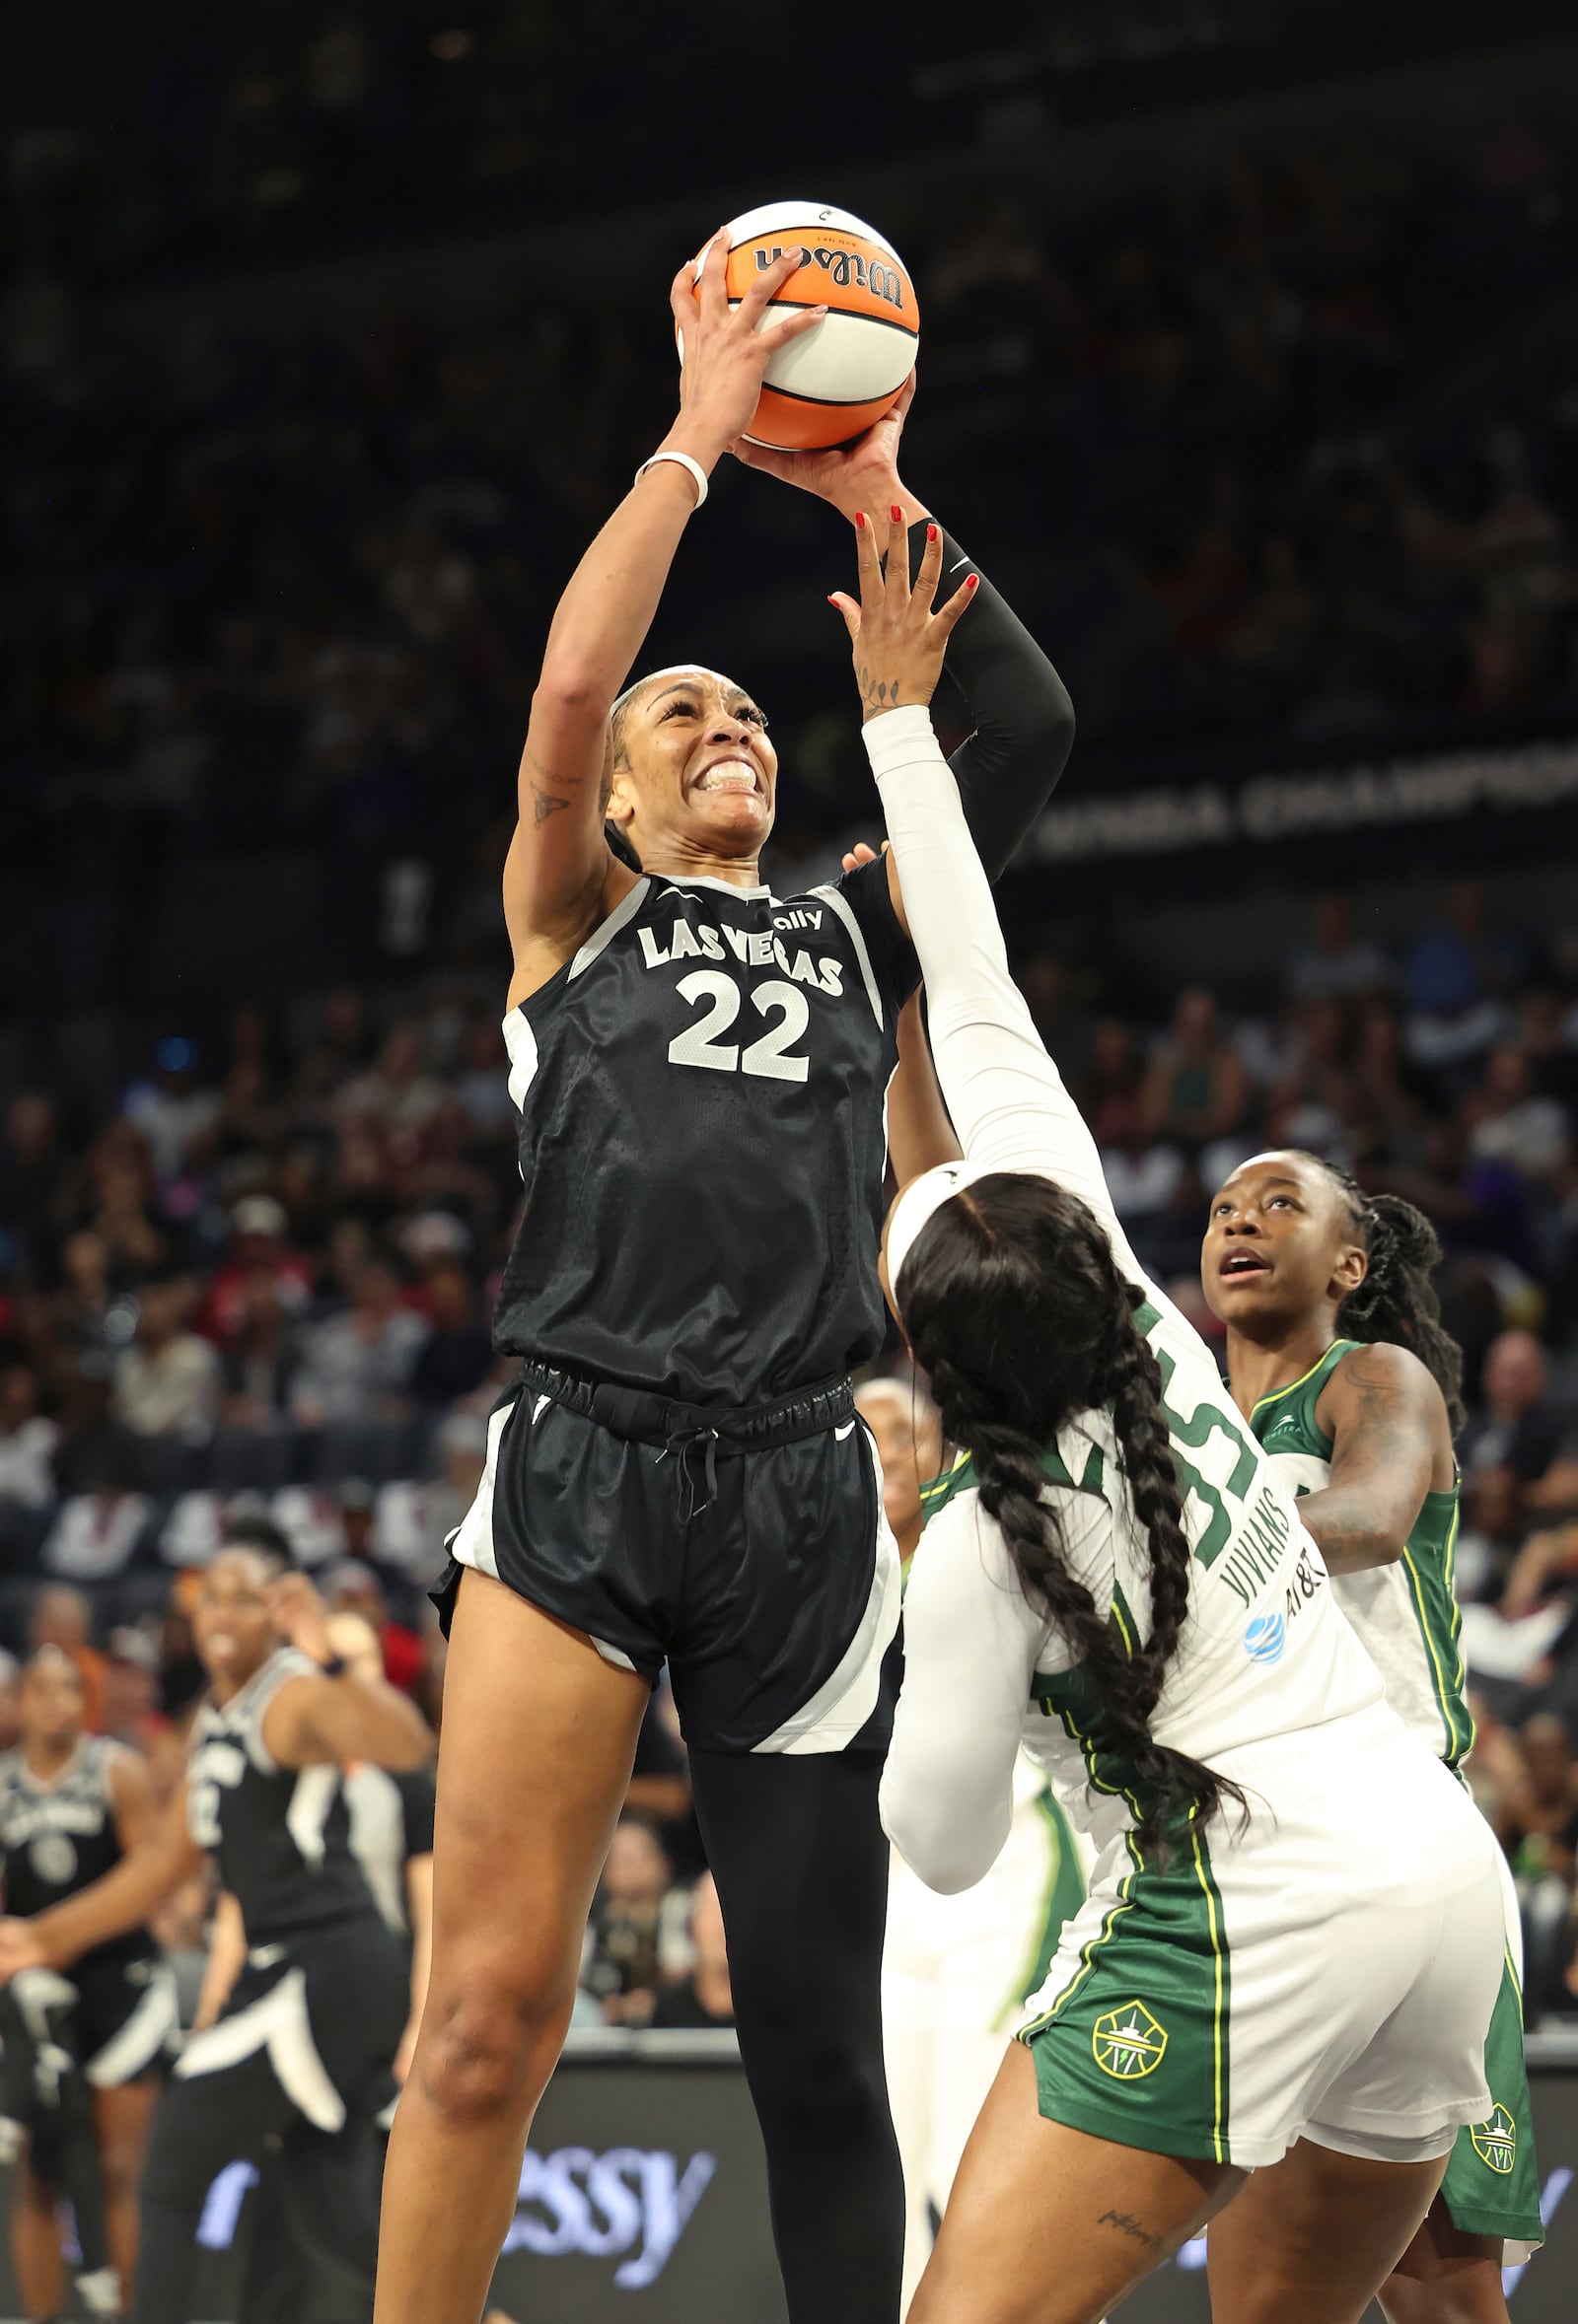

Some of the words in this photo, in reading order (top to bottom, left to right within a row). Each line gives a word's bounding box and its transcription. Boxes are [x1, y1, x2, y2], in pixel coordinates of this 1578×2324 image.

[637, 918, 726, 969] LAS
[772, 909, 823, 931] ally
[668, 969, 810, 1083] 22
[1219, 1486, 1291, 1609] VIVIANS
